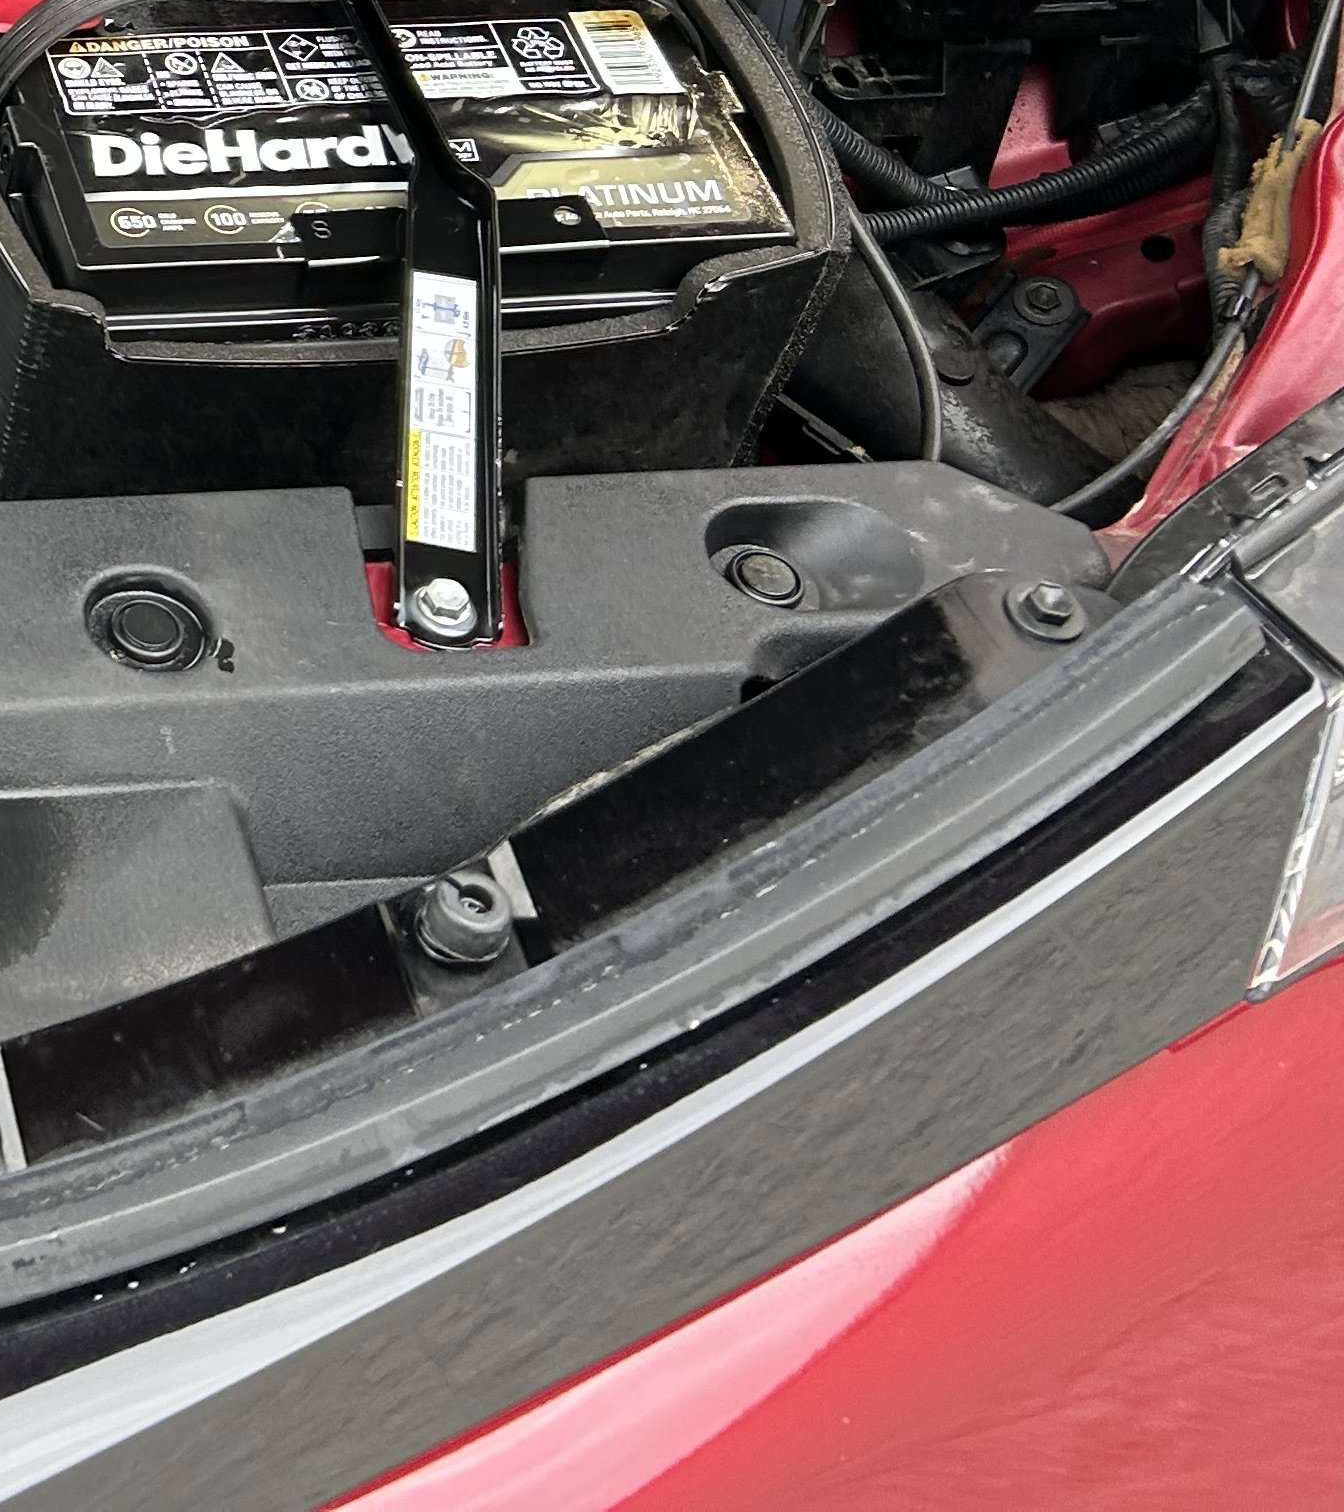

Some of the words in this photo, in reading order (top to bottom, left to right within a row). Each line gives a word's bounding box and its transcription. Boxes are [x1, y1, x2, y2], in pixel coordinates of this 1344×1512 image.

[85, 36, 250, 53] DANGER/POISON
[404, 51, 498, 62] ON-SPILLABLE
[117, 214, 158, 230] 650
[210, 212, 248, 227] 100
[311, 219, 333, 240] S
